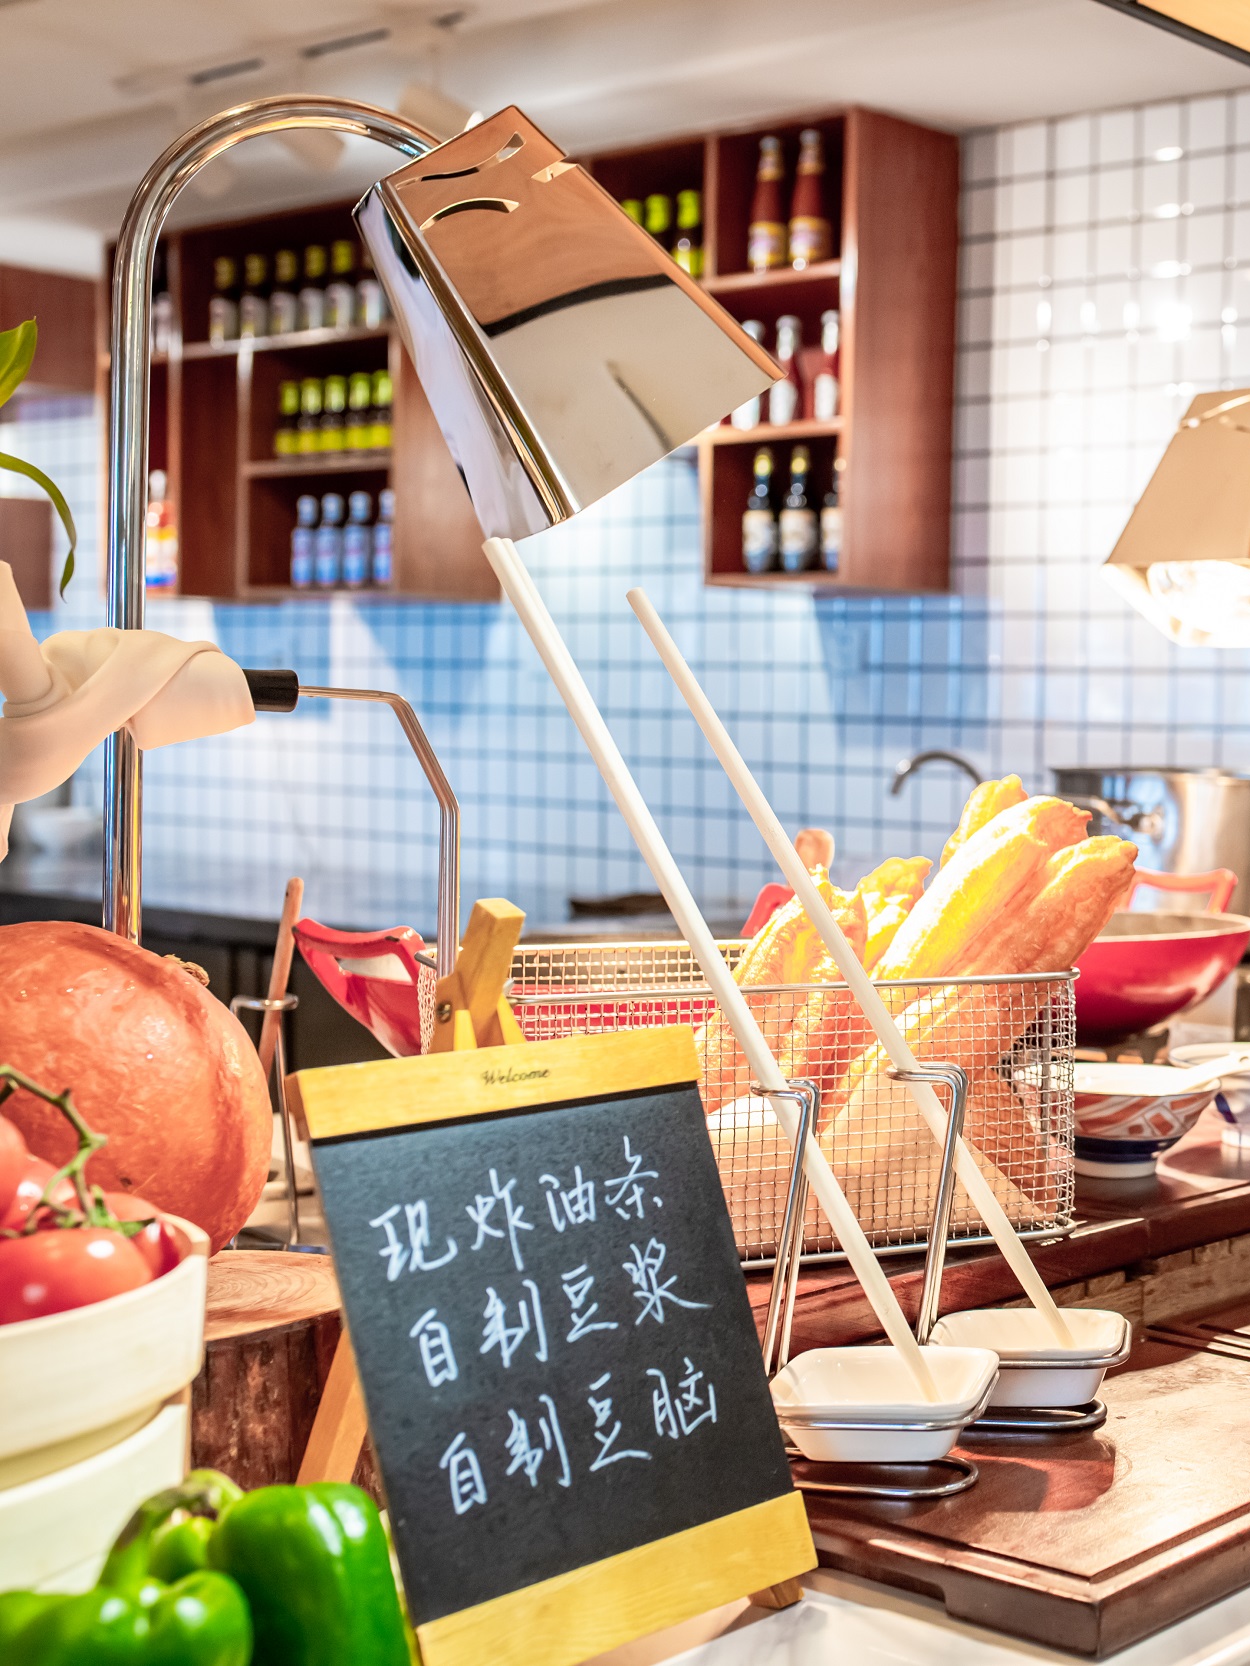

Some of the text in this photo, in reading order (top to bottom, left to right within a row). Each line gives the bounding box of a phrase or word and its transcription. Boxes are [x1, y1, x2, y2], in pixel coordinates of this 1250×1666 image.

[480, 1066, 550, 1086] Welcome
[369, 1135, 664, 1283] 现炸油条
[409, 1236, 713, 1388] 自制豆浆
[438, 1356, 719, 1516] 自制豆脑
